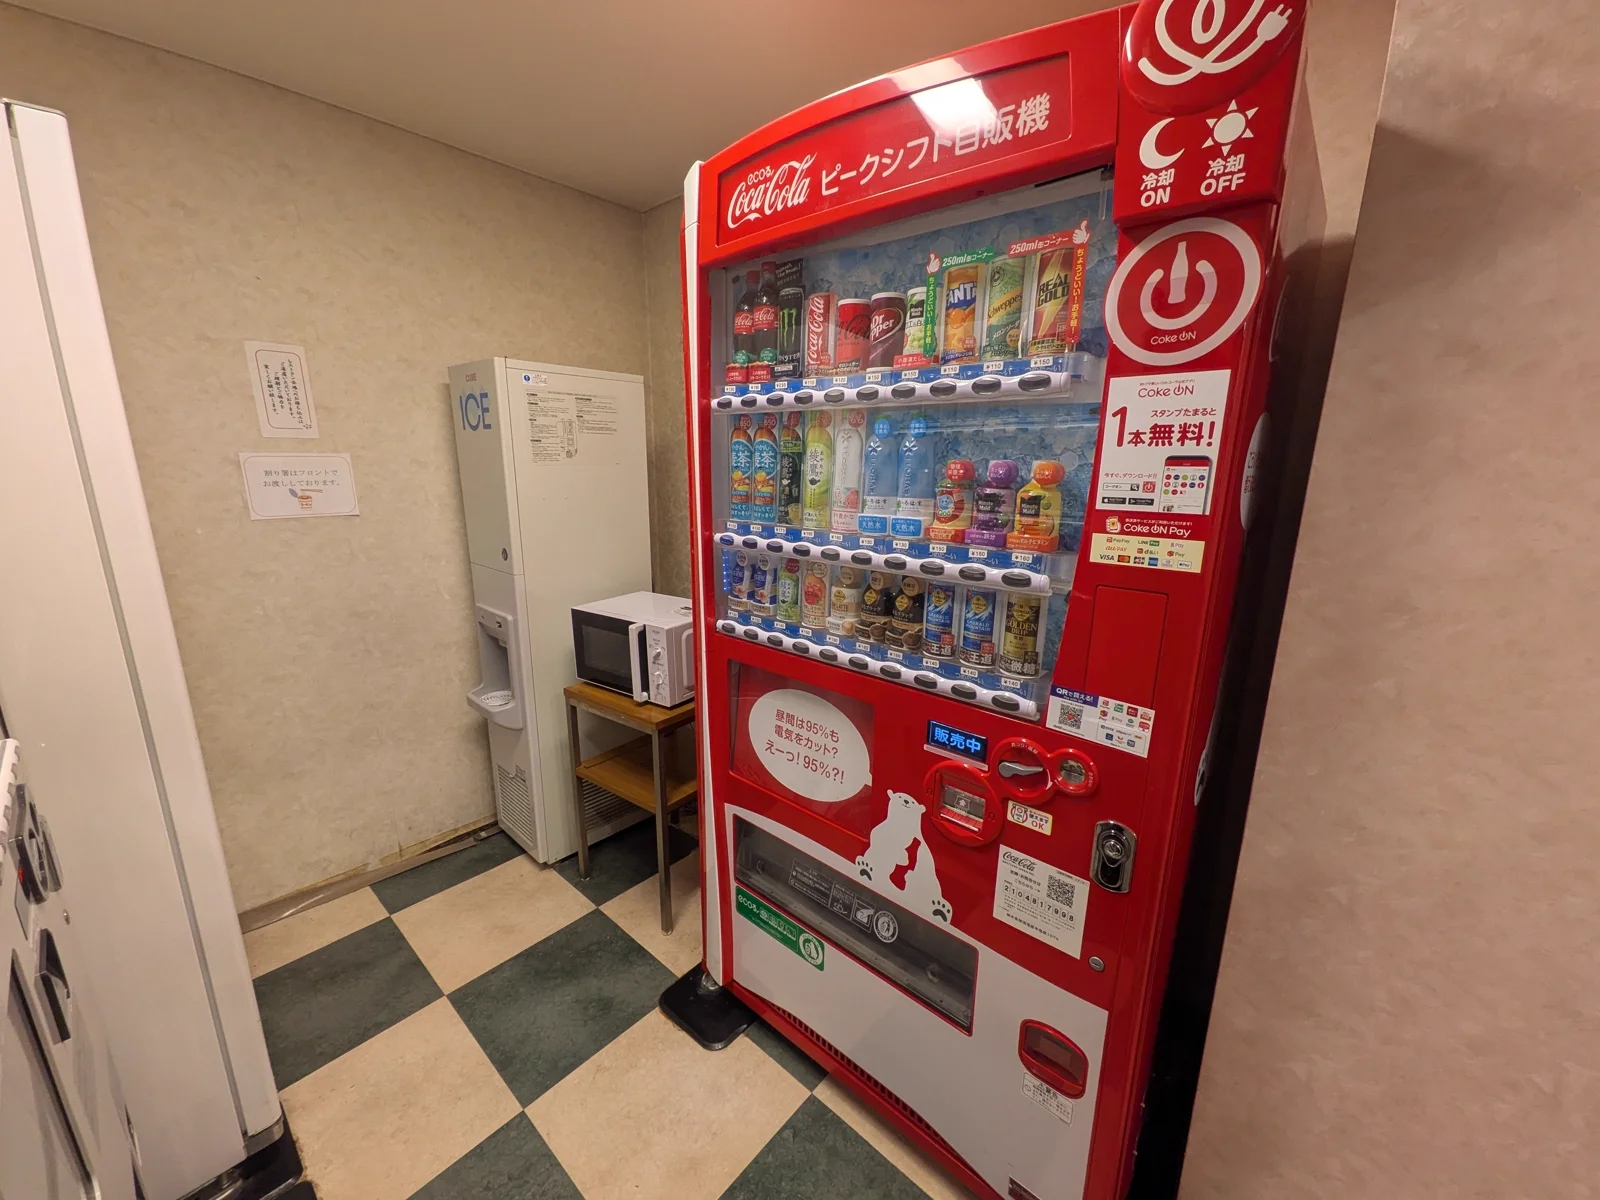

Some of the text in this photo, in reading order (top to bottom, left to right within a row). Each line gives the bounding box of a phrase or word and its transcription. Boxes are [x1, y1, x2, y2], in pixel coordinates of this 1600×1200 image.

[727, 92, 1051, 229] Coca-Cola ピークシフト自販機
[1206, 153, 1245, 177] 冷却
[1140, 168, 1175, 190] 冷却
[1200, 173, 1246, 195] OFF
[1140, 187, 1171, 207] ON
[1009, 236, 1069, 254] 250ml缶コーナー
[942, 251, 994, 267] 250ml缶コーナー
[1039, 273, 1070, 296] REAL
[987, 292, 1023, 320] Schweppes
[1037, 285, 1069, 308] GOLD
[872, 313, 885, 328] Dr
[807, 296, 825, 365] Coca-Cola
[1151, 330, 1197, 345] Coke ON
[1138, 384, 1194, 398] Coke ON
[460, 392, 492, 431] ICE
[1151, 408, 1217, 418] スタンプたまると
[1111, 405, 1216, 448] 1本無料!
[810, 448, 820, 477] 綾鷹
[263, 469, 338, 477] 割り箸はフロントで
[895, 524, 915, 532] 天然水
[1124, 523, 1191, 538] Coke ON Pay
[965, 624, 990, 632] MOUNTAIN
[966, 619, 989, 627] EMERALD
[1006, 620, 1037, 631] GOLDEN
[931, 644, 951, 655] 王道
[970, 652, 992, 665] 王道
[1056, 687, 1094, 702] QRで買える!
[775, 708, 840, 743] 昼間は95%も
[774, 724, 838, 759] 電気をカット?
[934, 727, 981, 753] 販売中
[1031, 821, 1044, 830] OK
[1003, 851, 1038, 872] Coca-Cola
